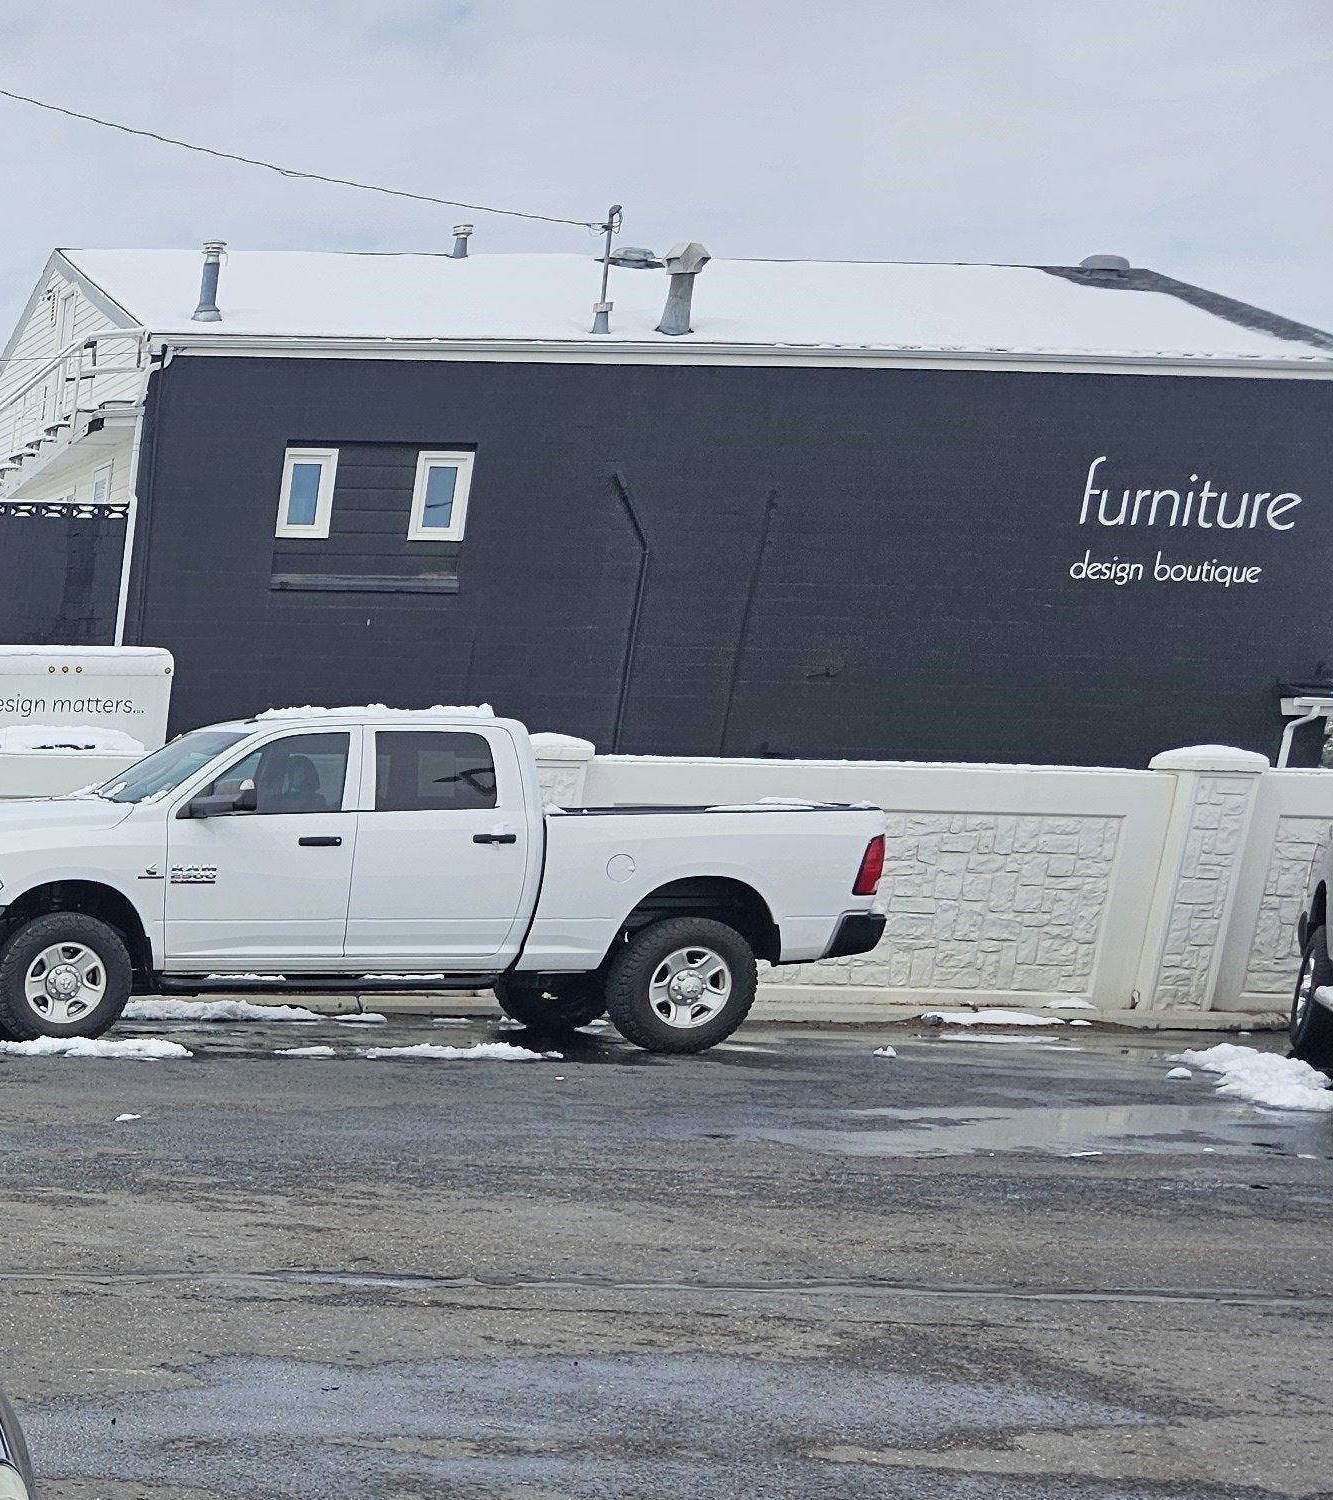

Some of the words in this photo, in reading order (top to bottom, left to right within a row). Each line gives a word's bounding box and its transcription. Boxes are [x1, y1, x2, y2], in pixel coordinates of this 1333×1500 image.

[1079, 456, 1303, 531] furniture
[1069, 549, 1143, 586] design
[1153, 551, 1262, 588] boutique
[52, 694, 145, 714] matters...
[171, 863, 217, 872] RAM
